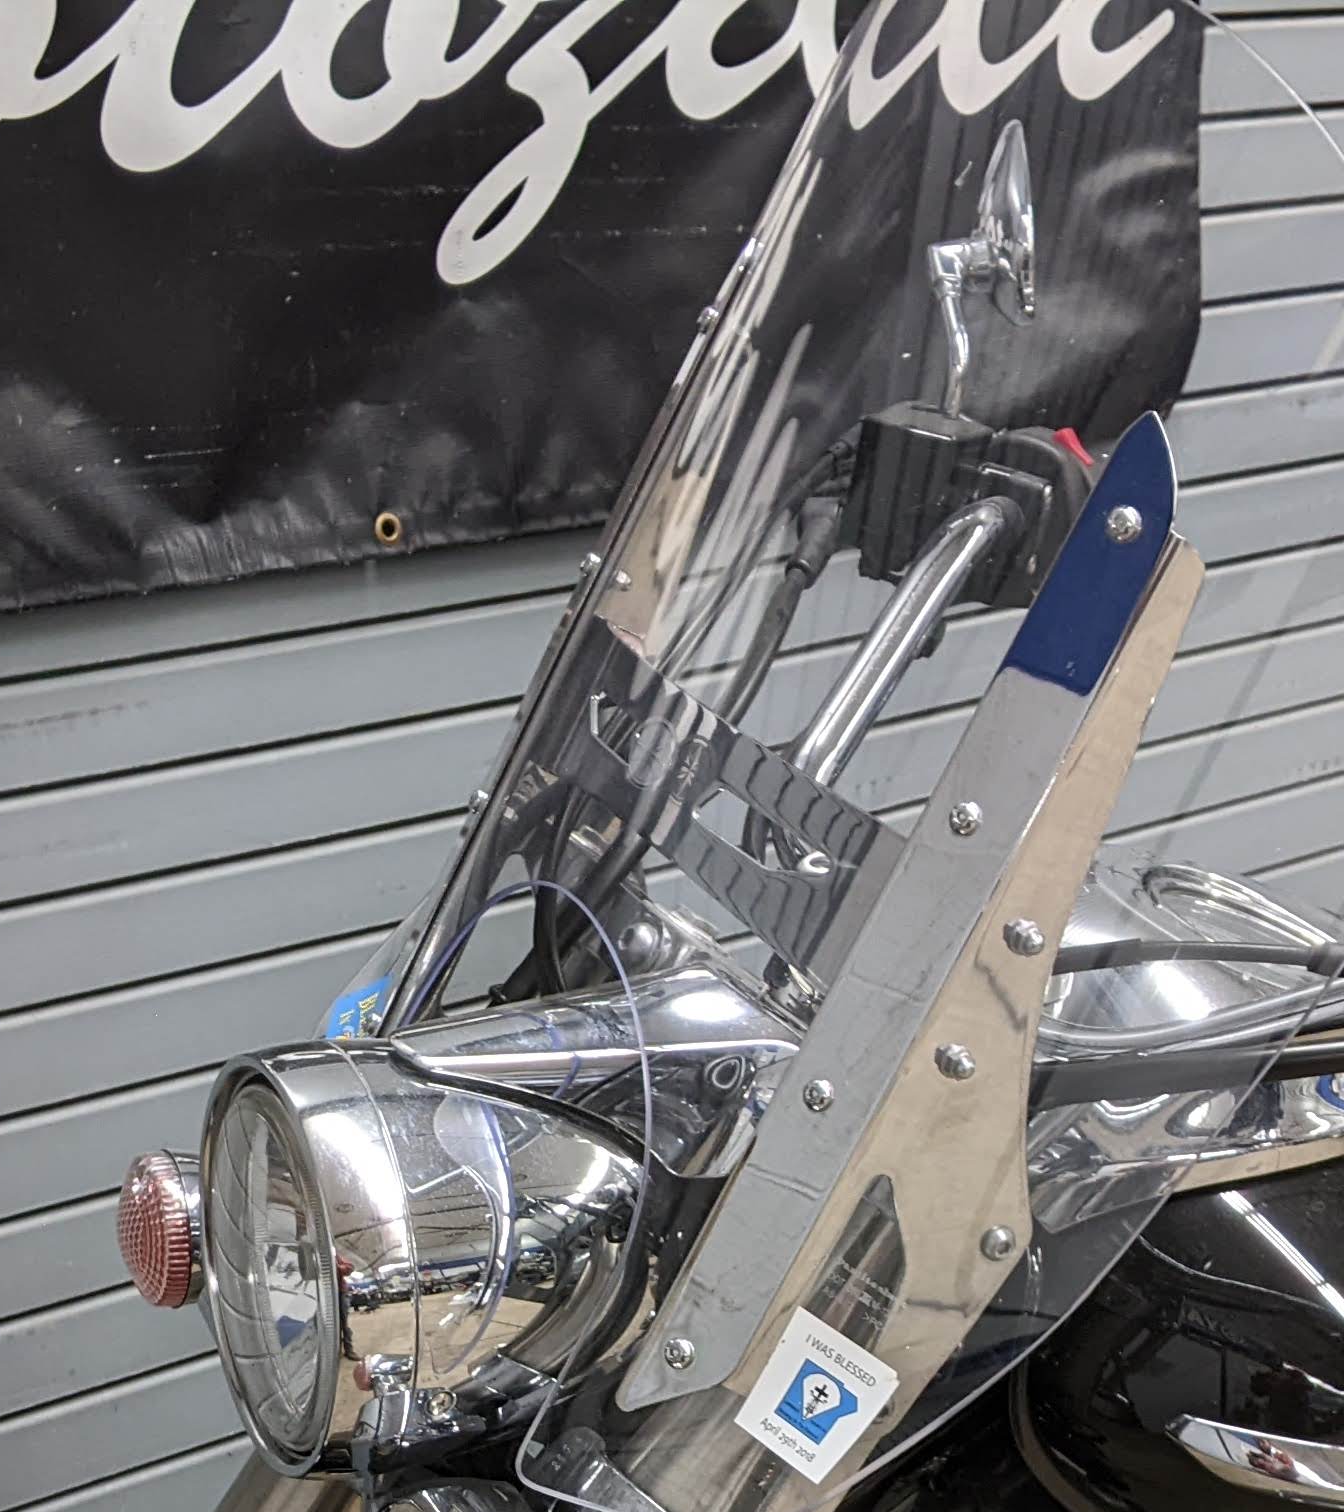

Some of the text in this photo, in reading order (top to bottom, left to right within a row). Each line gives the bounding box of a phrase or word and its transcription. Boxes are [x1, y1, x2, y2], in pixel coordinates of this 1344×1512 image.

[811, 1336, 835, 1359] WAS
[834, 1353, 876, 1387] BLESSED
[760, 1417, 817, 1463] April 29th 2018
